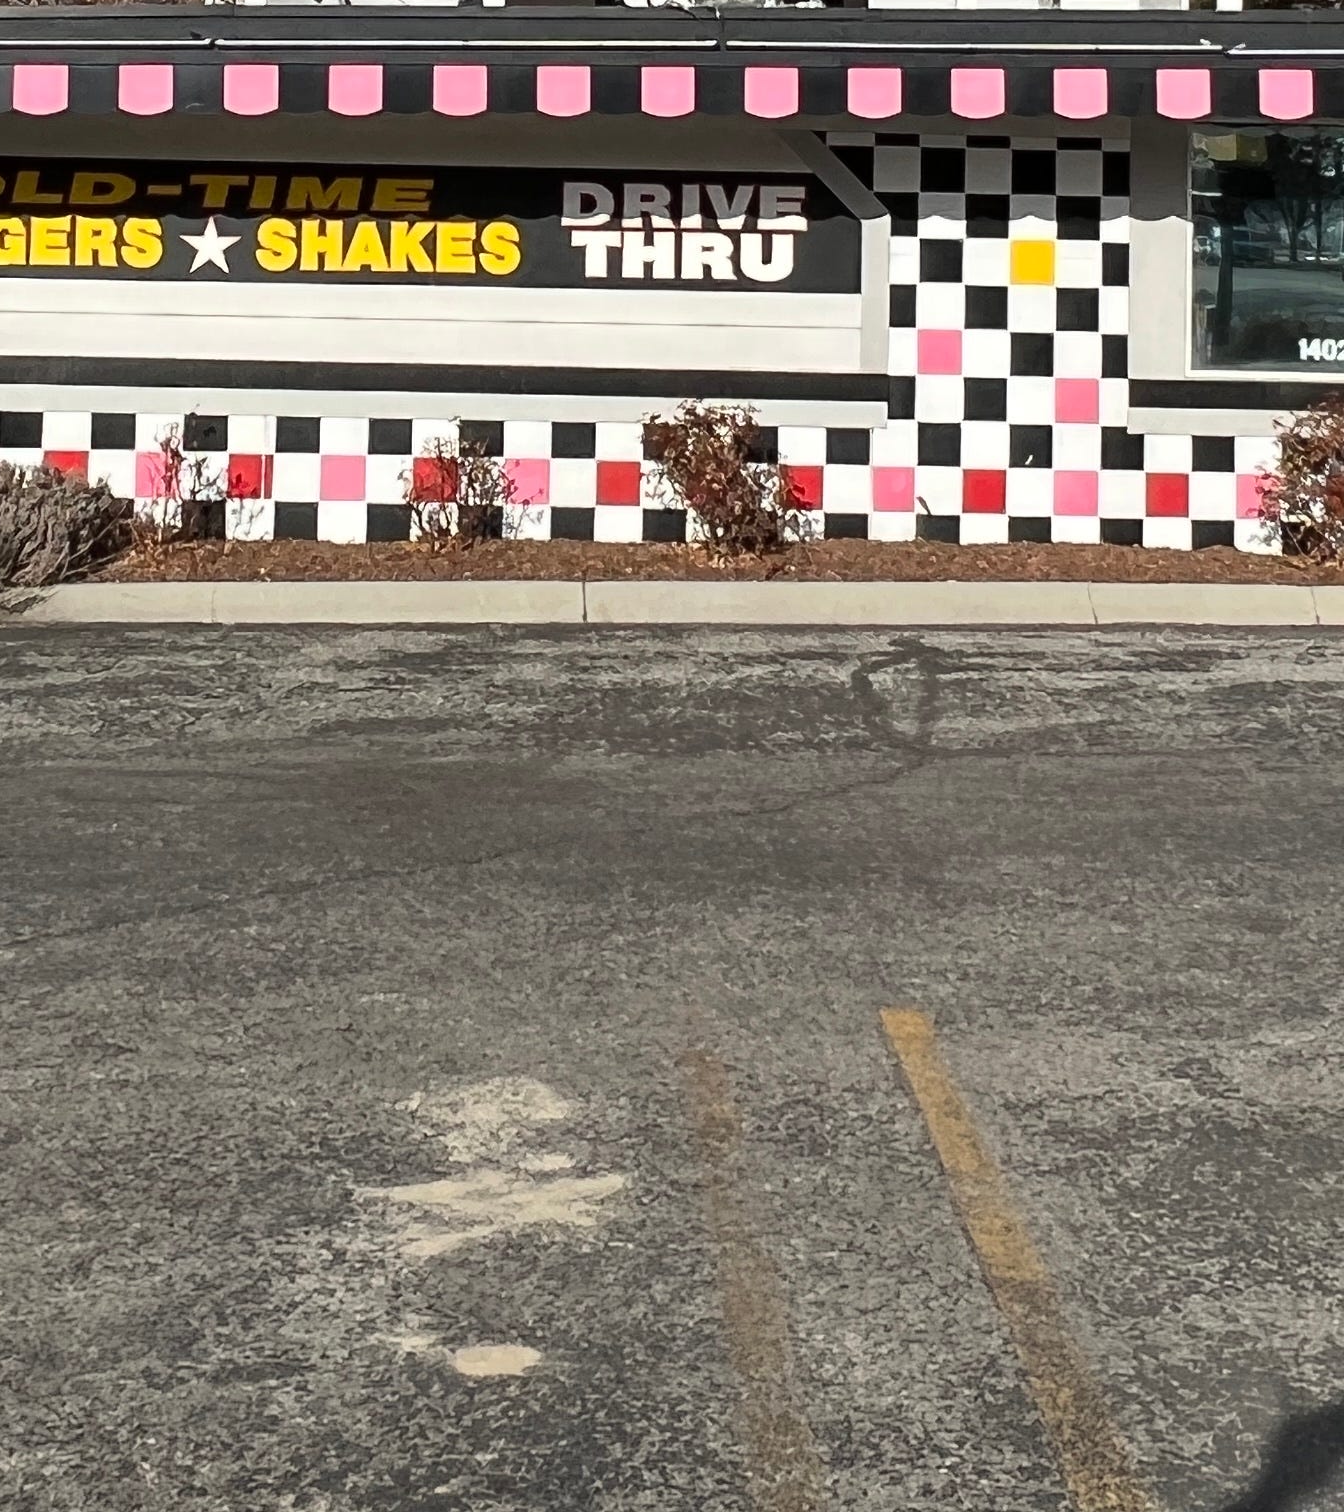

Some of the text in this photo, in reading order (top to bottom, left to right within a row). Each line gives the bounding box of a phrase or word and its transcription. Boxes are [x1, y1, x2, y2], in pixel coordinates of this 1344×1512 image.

[560, 181, 809, 232] DRIVE
[254, 215, 524, 276] SHAKES
[570, 230, 795, 283] THRU
